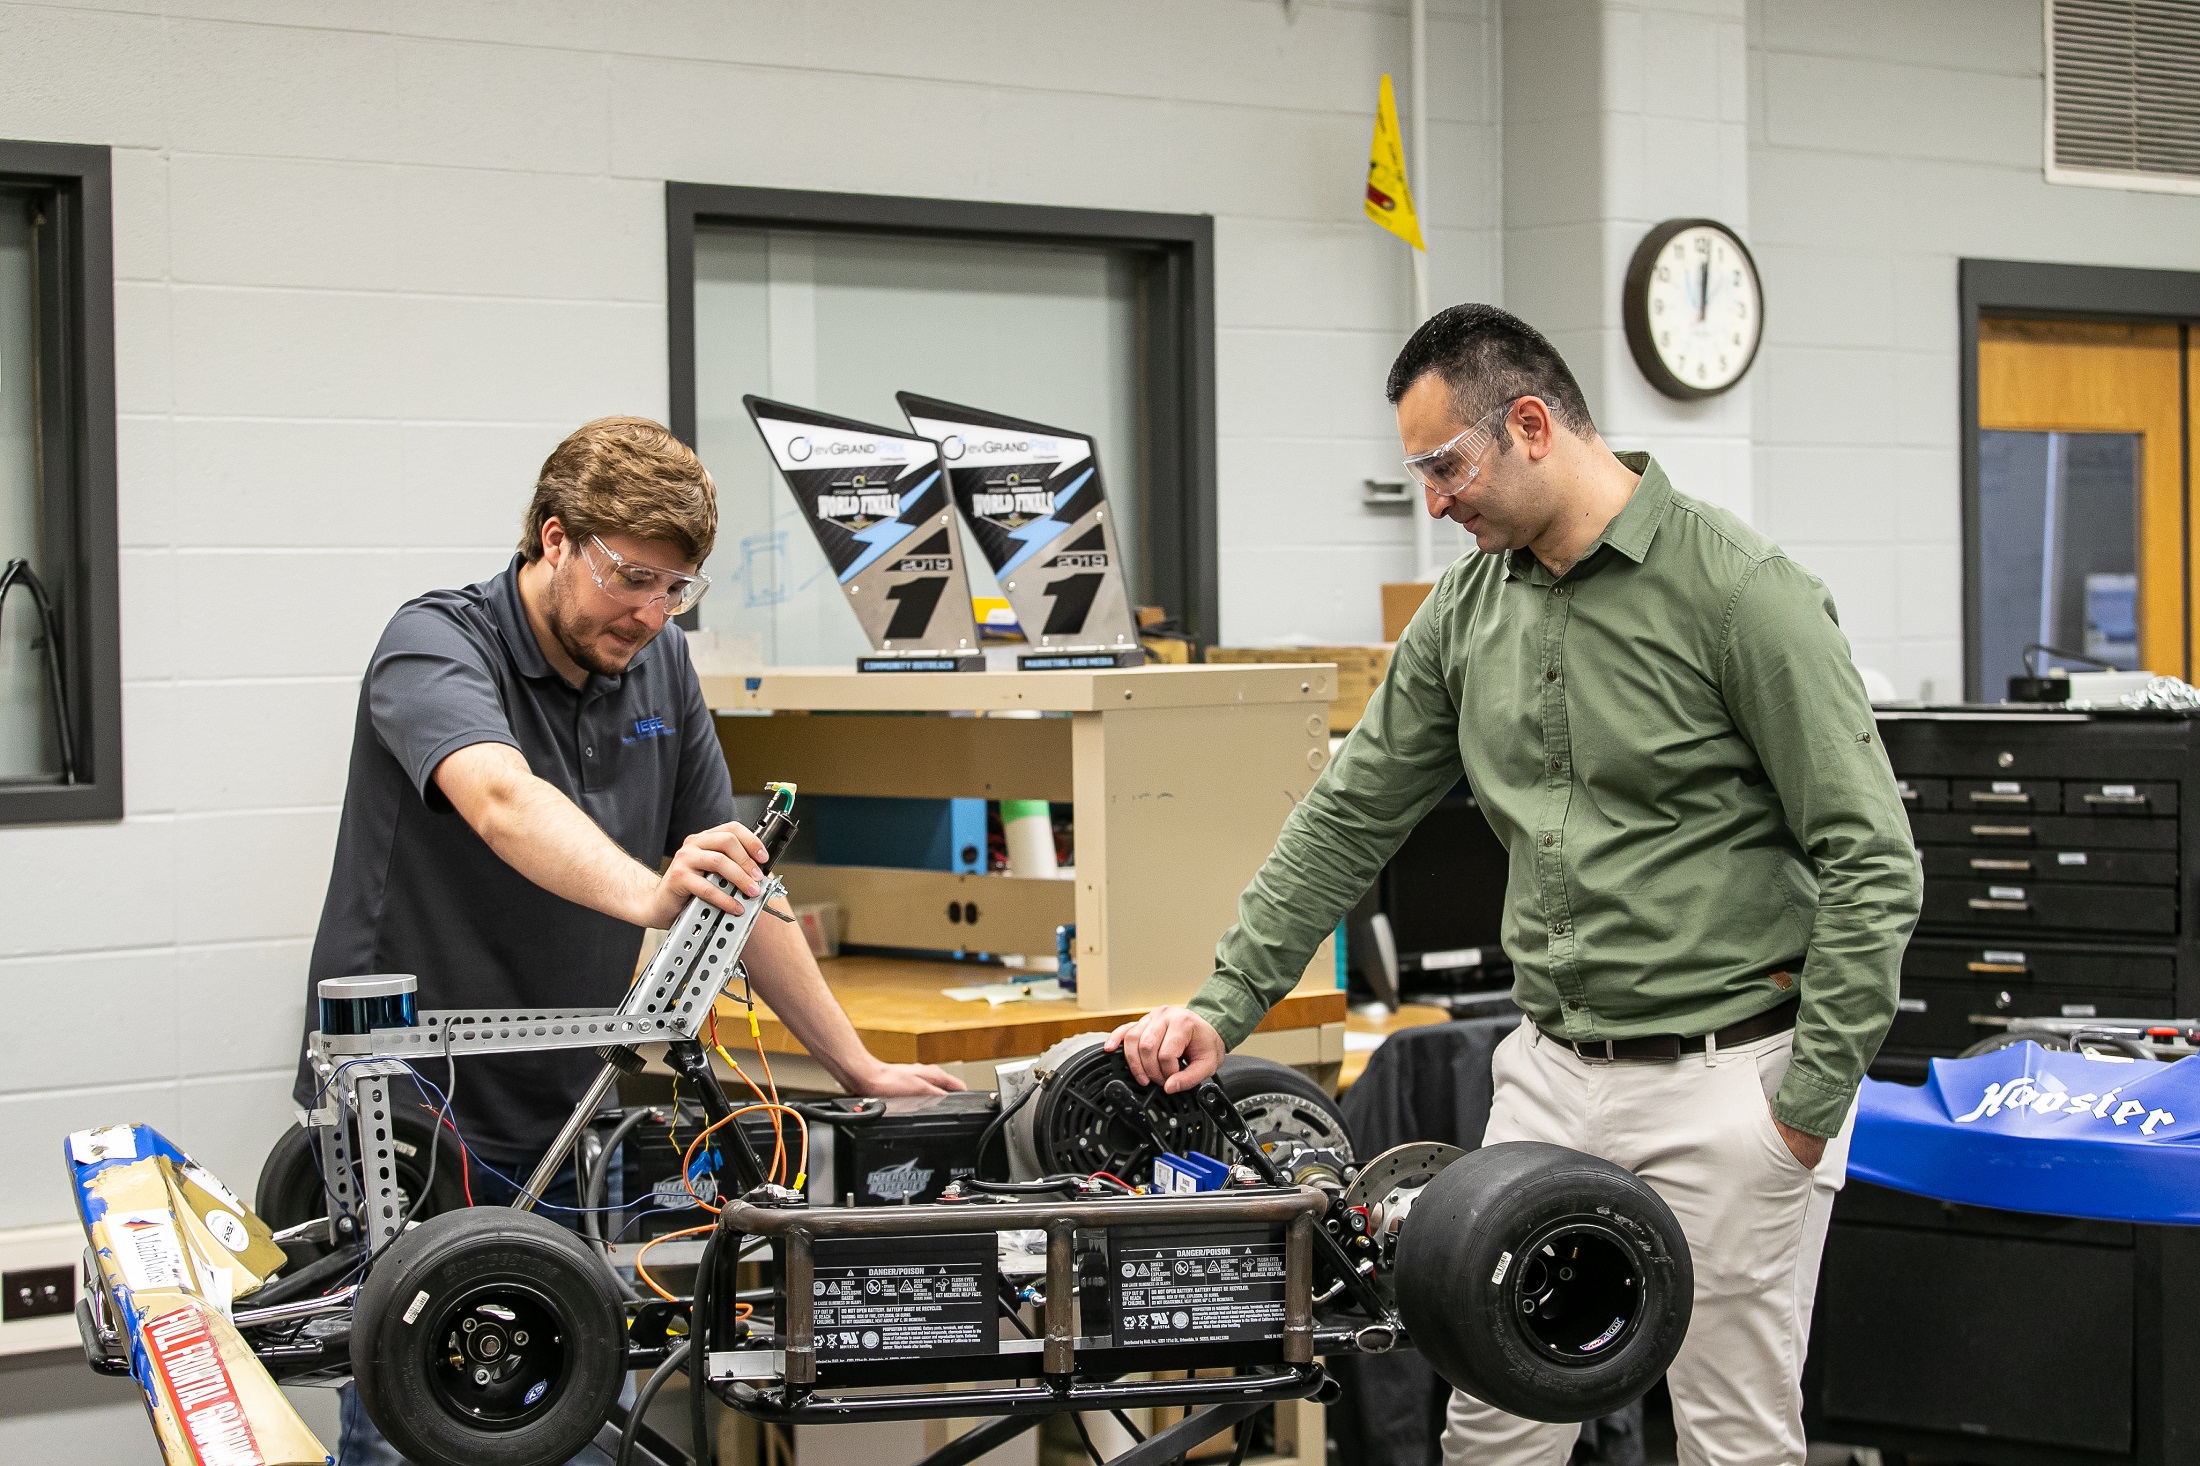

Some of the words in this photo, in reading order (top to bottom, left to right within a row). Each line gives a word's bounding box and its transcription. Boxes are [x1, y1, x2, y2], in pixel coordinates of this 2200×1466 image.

[900, 558, 950, 572] 2019
[1056, 554, 1106, 569] 2019
[883, 577, 949, 640] 1
[1041, 573, 1104, 636] 1
[634, 716, 665, 734] IEEE
[1953, 1076, 2177, 1137] Hoosier
[1176, 1248, 1231, 1258] DANGER/POISON
[868, 1267, 925, 1276] DANGER/POISON
[146, 1308, 207, 1353] FULL
[161, 1339, 231, 1412] FRONTAL
